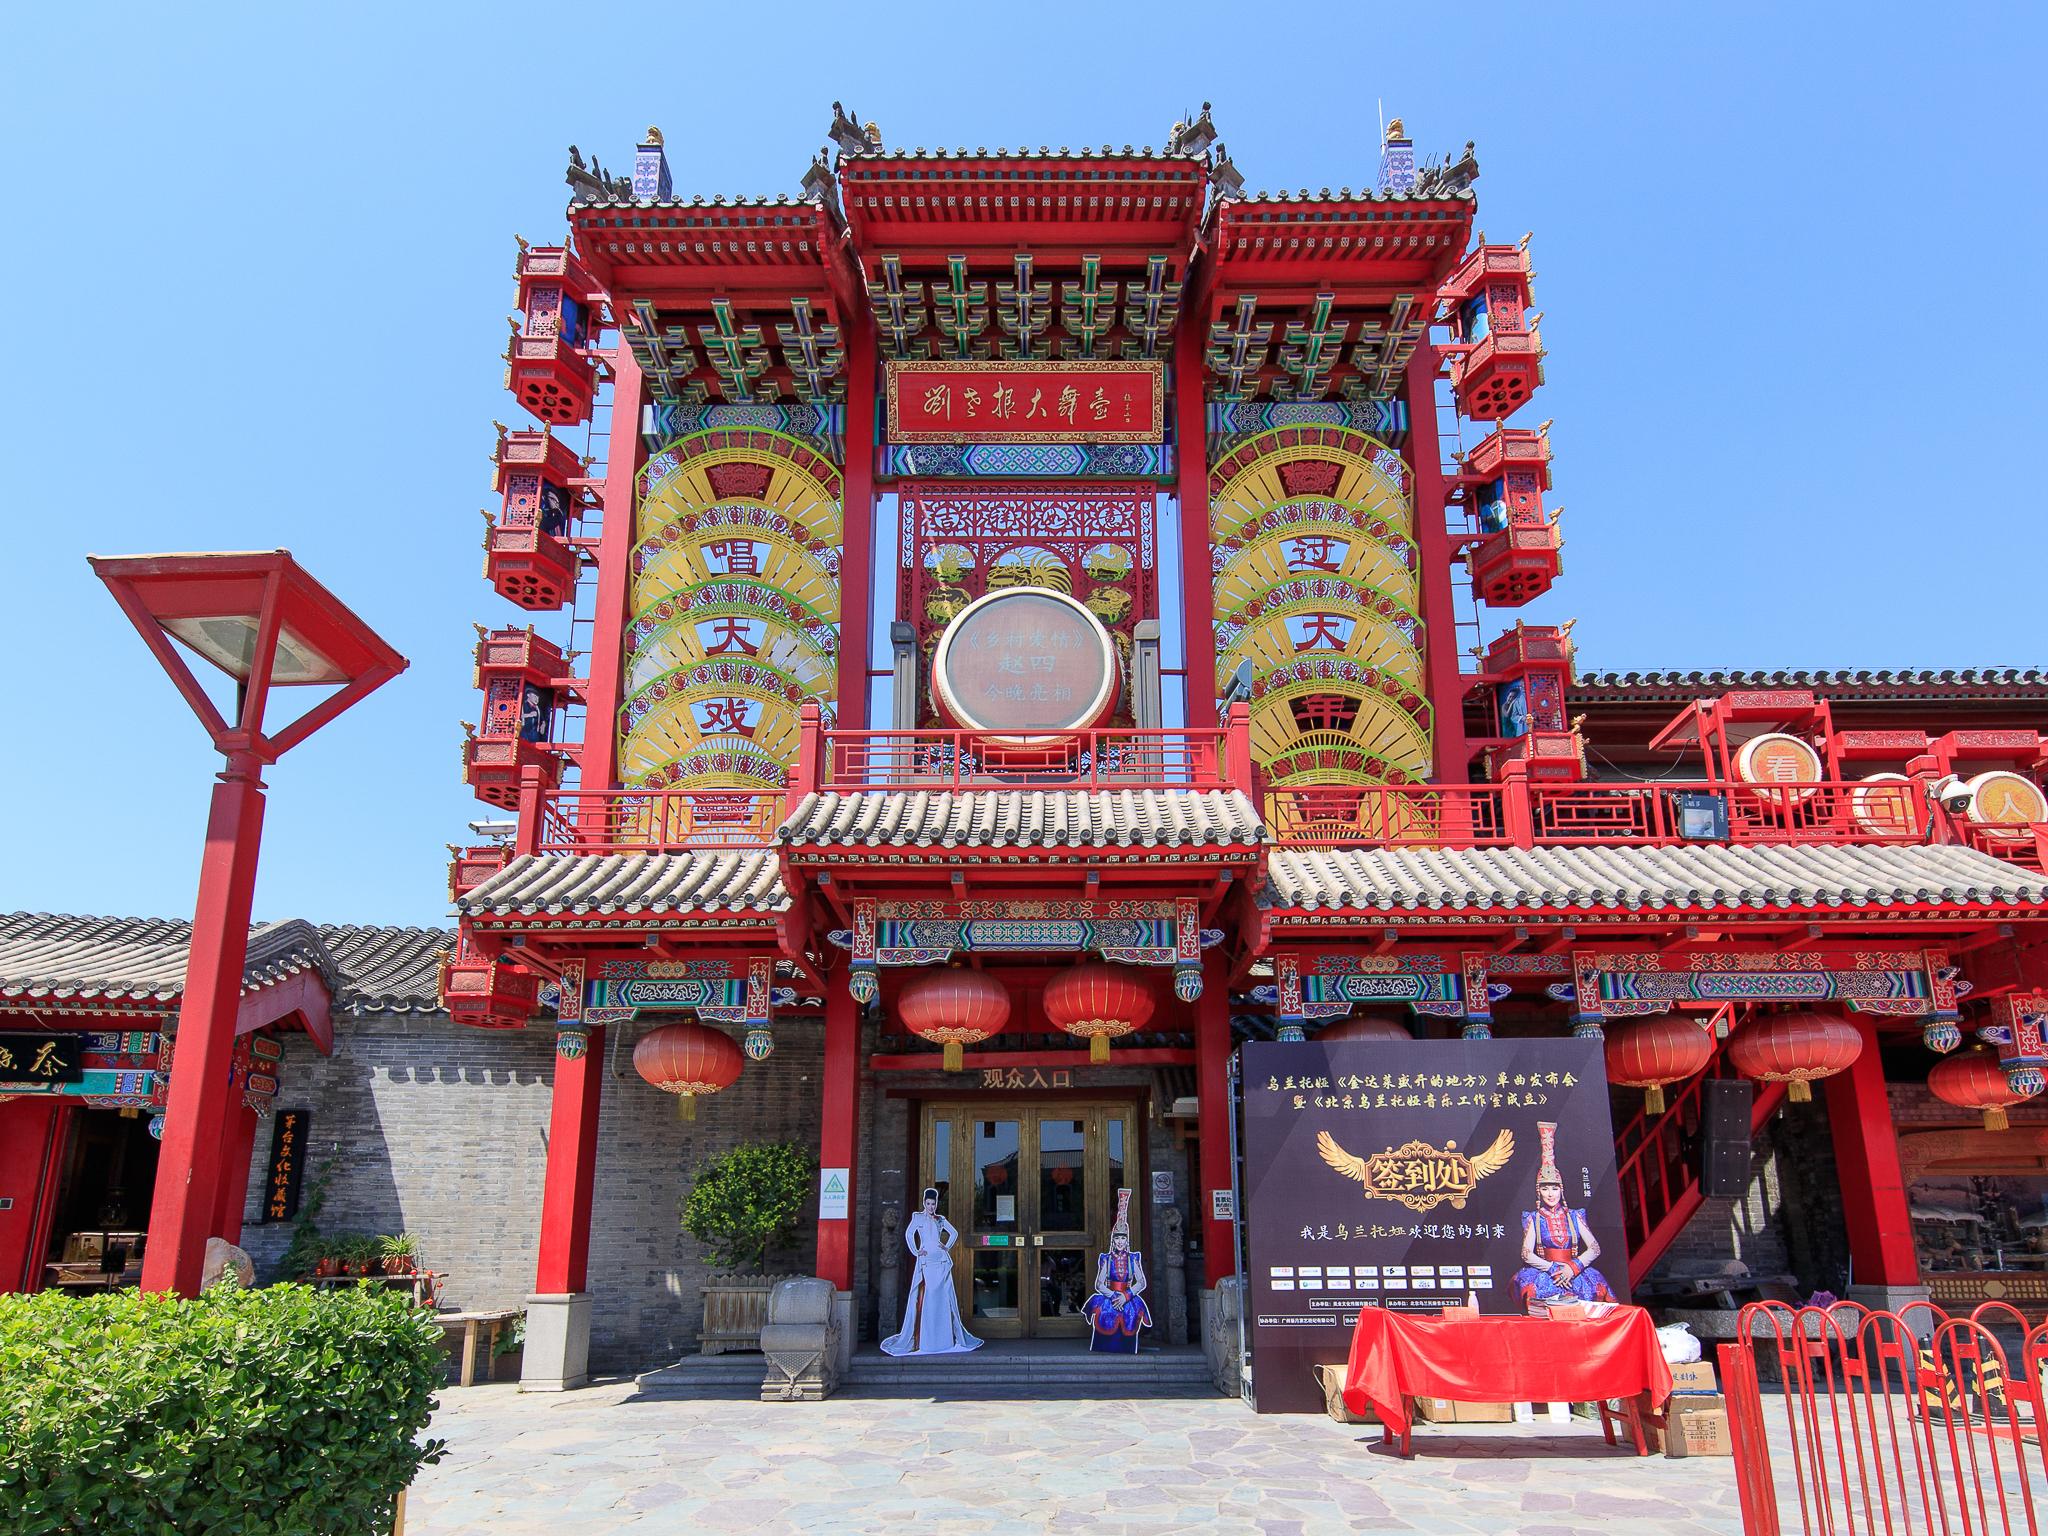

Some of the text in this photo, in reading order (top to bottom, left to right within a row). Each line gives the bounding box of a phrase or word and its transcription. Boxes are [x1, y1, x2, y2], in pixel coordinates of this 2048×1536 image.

[1766, 755, 1799, 782] 看
[1996, 792, 2029, 820] 人
[983, 1068, 1070, 1088] 观众入口
[1372, 1159, 1468, 1191] 签到处
